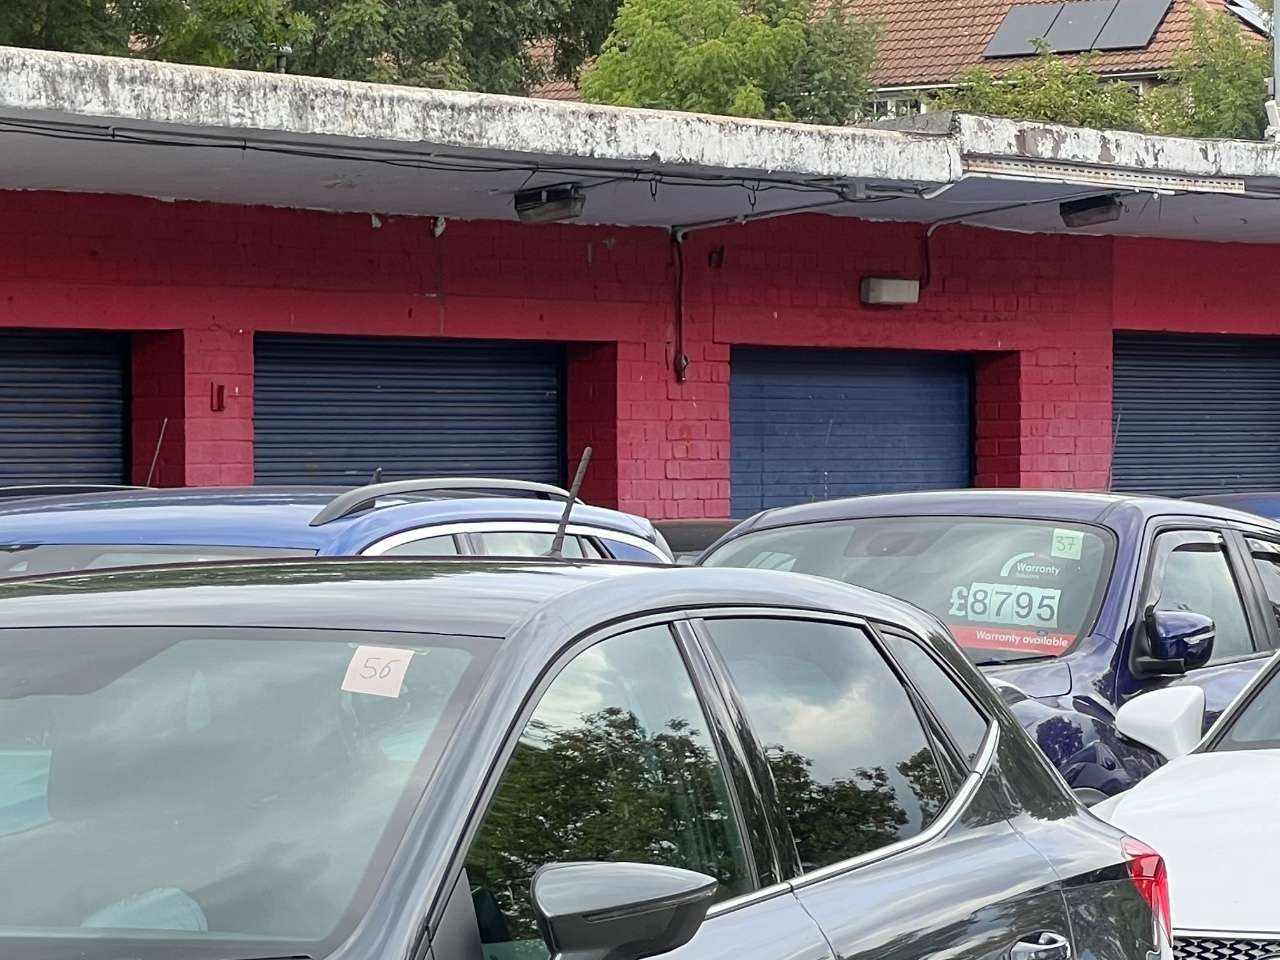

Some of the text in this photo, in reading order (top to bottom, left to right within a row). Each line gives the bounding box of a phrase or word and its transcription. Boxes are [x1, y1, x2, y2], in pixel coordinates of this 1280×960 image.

[1055, 536, 1076, 551] 37
[1016, 561, 1061, 577] Warranty
[948, 585, 1056, 622] £8795
[976, 630, 1069, 647] Warranty available
[360, 657, 401, 680] 56
